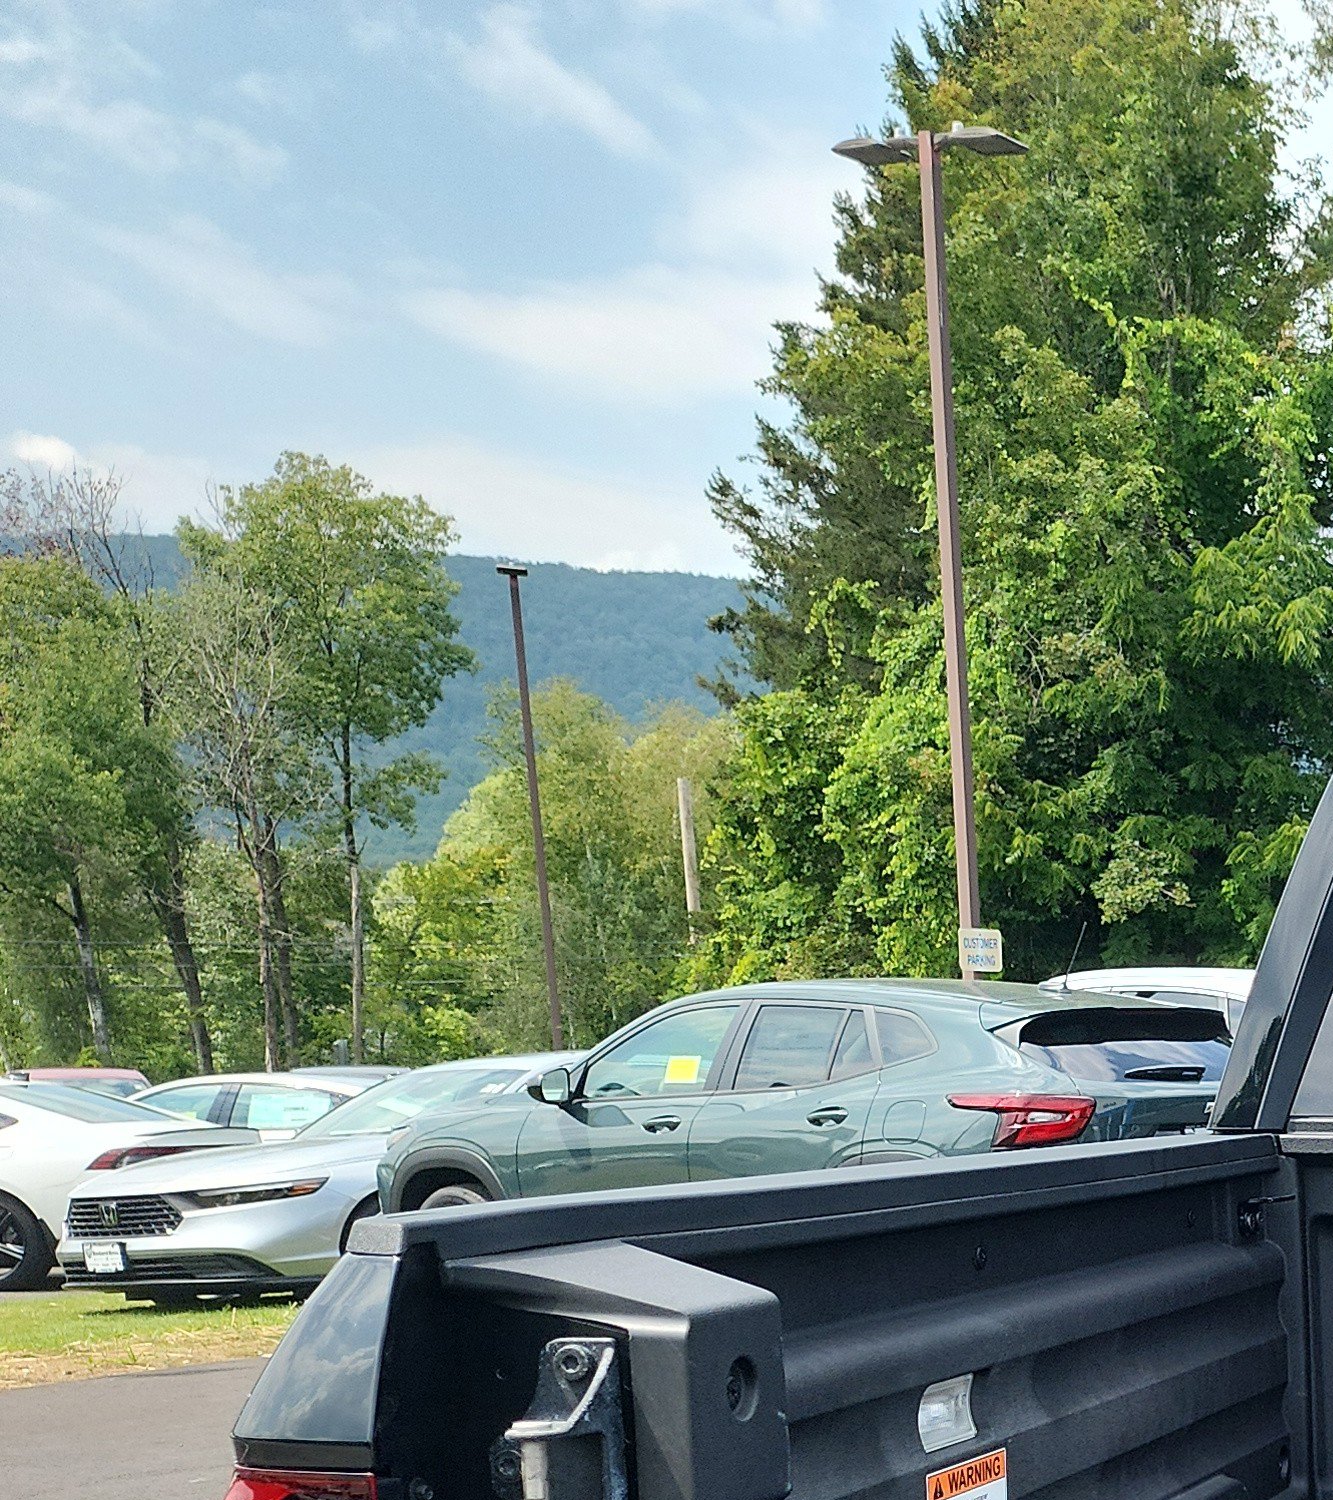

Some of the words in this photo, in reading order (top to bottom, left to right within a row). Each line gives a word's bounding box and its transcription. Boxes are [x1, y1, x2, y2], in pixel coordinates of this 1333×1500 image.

[963, 937, 998, 949] CUSTOMER
[967, 954, 996, 966] PARKING
[947, 1456, 1001, 1494] WARNING
